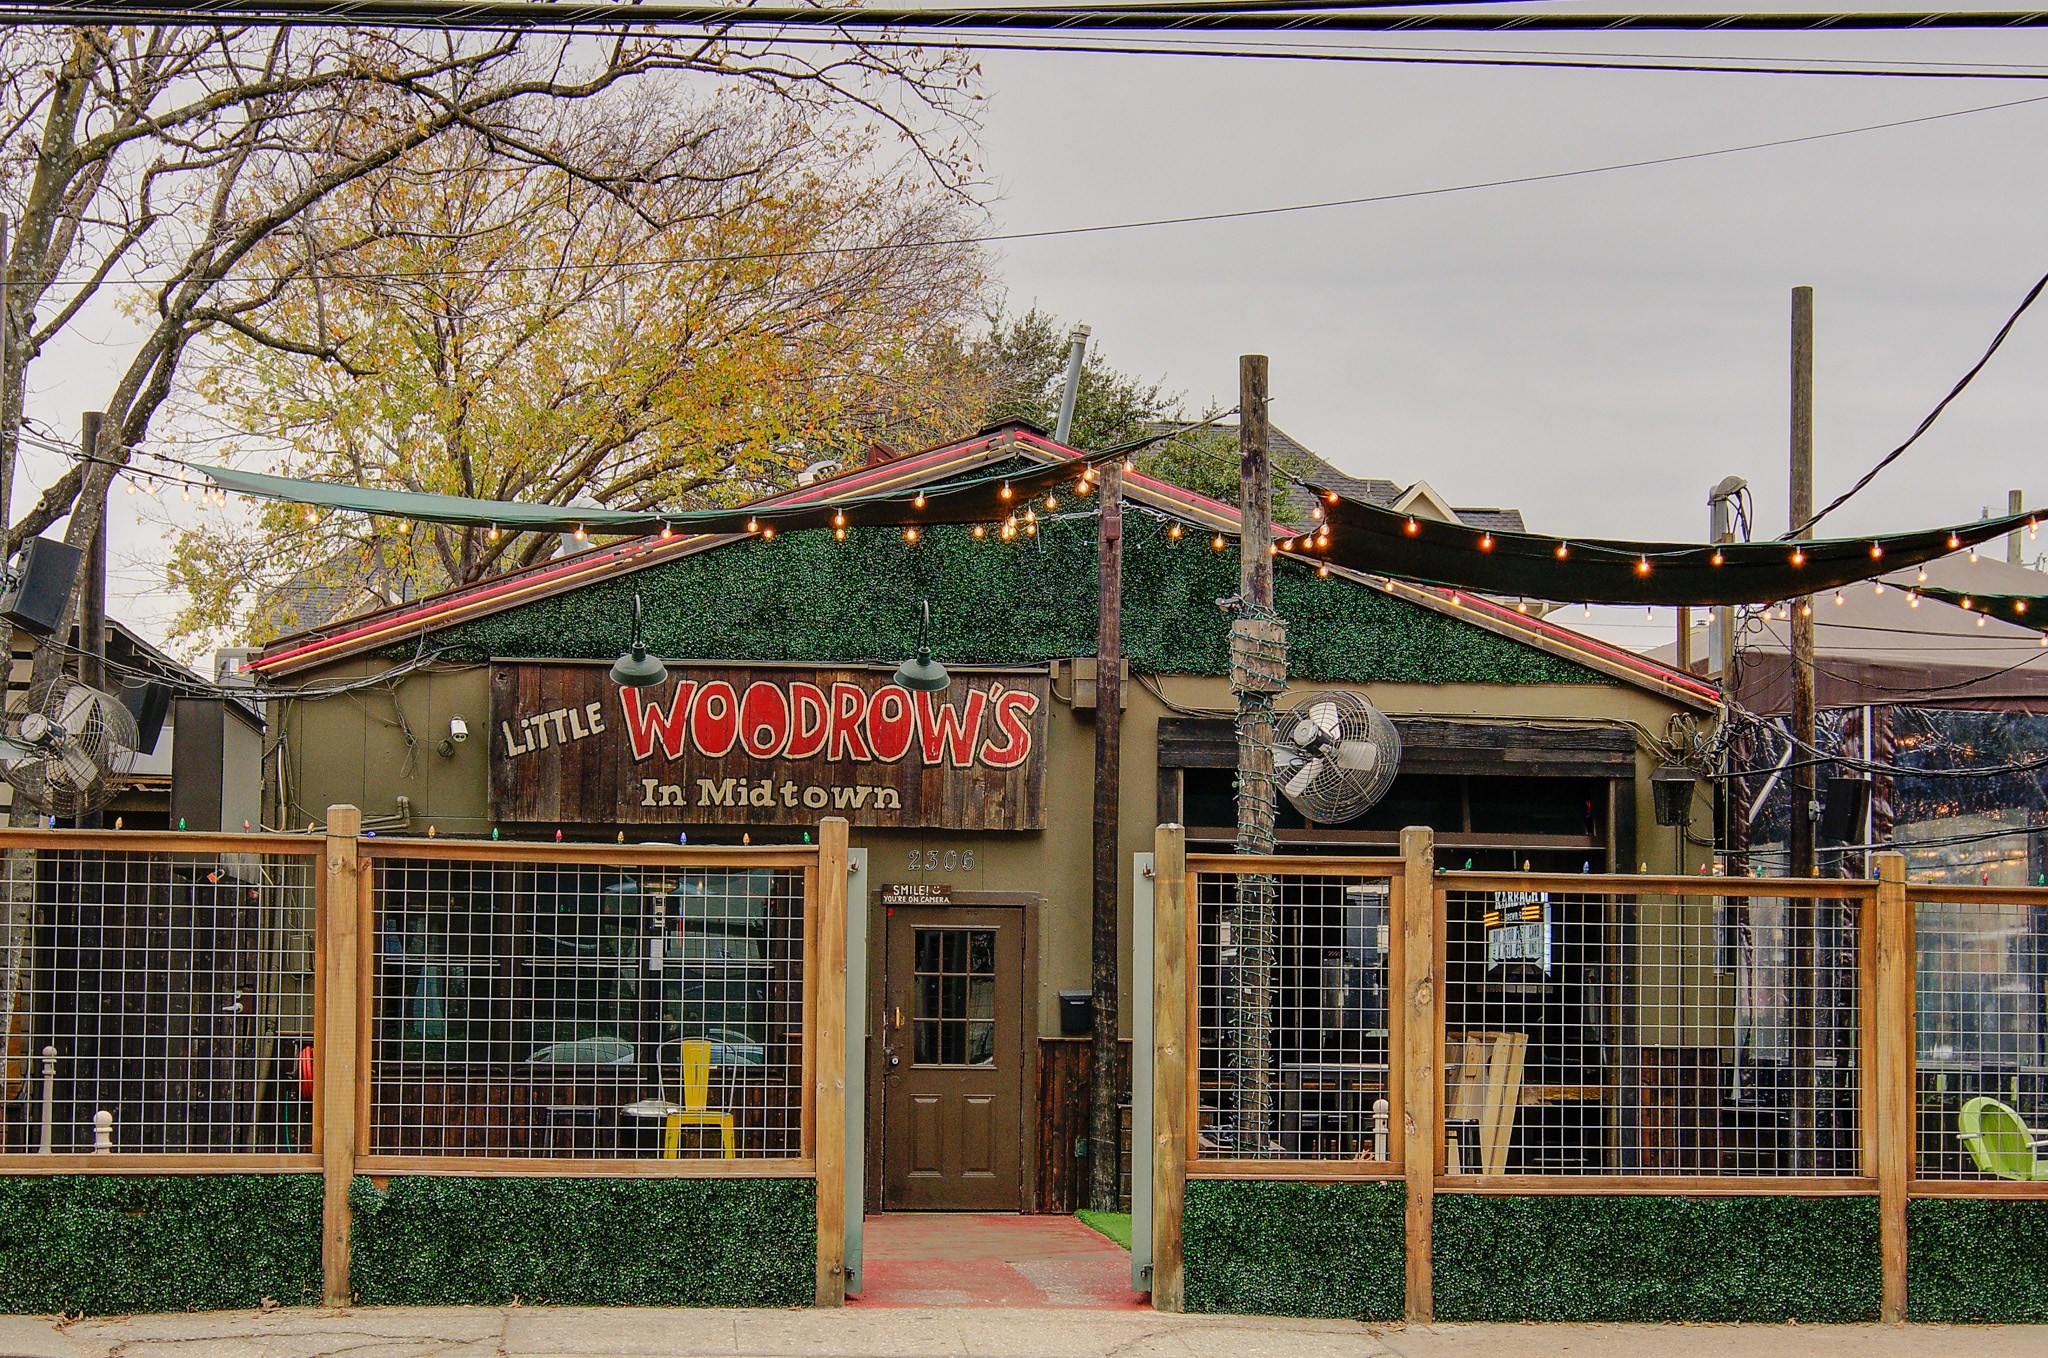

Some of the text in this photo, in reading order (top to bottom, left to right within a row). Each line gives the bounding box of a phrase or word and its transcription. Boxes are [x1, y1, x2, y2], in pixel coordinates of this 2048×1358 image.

[618, 680, 1040, 768] WOODROW'S
[641, 778, 902, 809] In Midtown
[908, 849, 975, 872] 2306
[883, 895, 907, 903] YOU'RE
[920, 896, 950, 904] CAMERA
[893, 885, 929, 896] SMILE!
[1495, 891, 1538, 909] KARBACH
